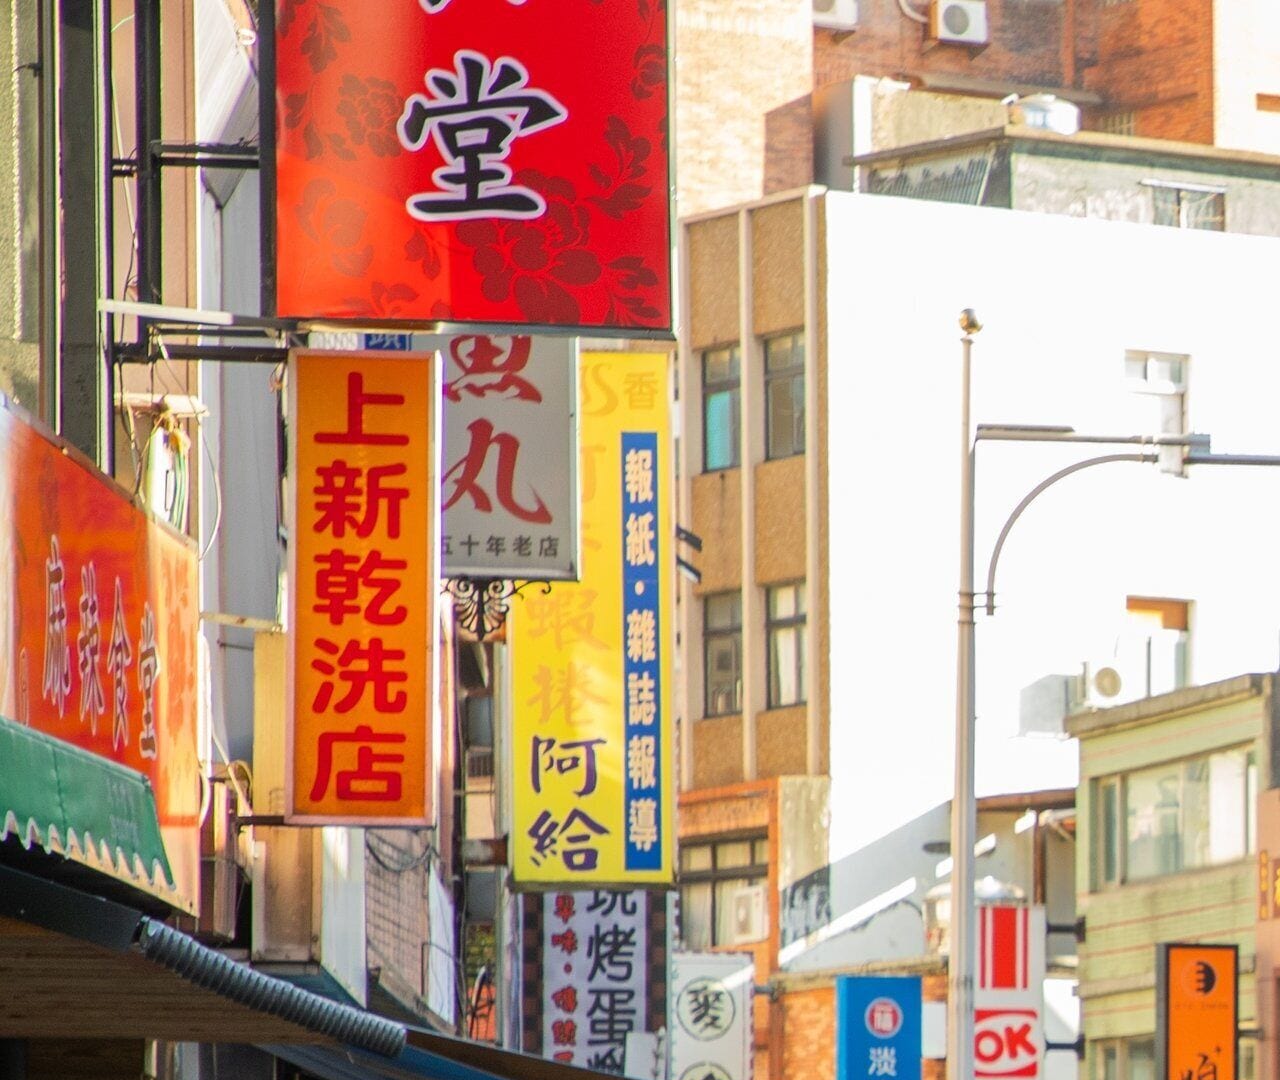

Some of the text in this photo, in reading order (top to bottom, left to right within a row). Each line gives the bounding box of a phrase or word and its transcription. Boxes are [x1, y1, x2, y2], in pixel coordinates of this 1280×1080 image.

[398, 0, 569, 222] 堂
[311, 371, 410, 803] 上新乾洗店
[527, 733, 611, 872] 阿給
[974, 1023, 1037, 1064] OK
